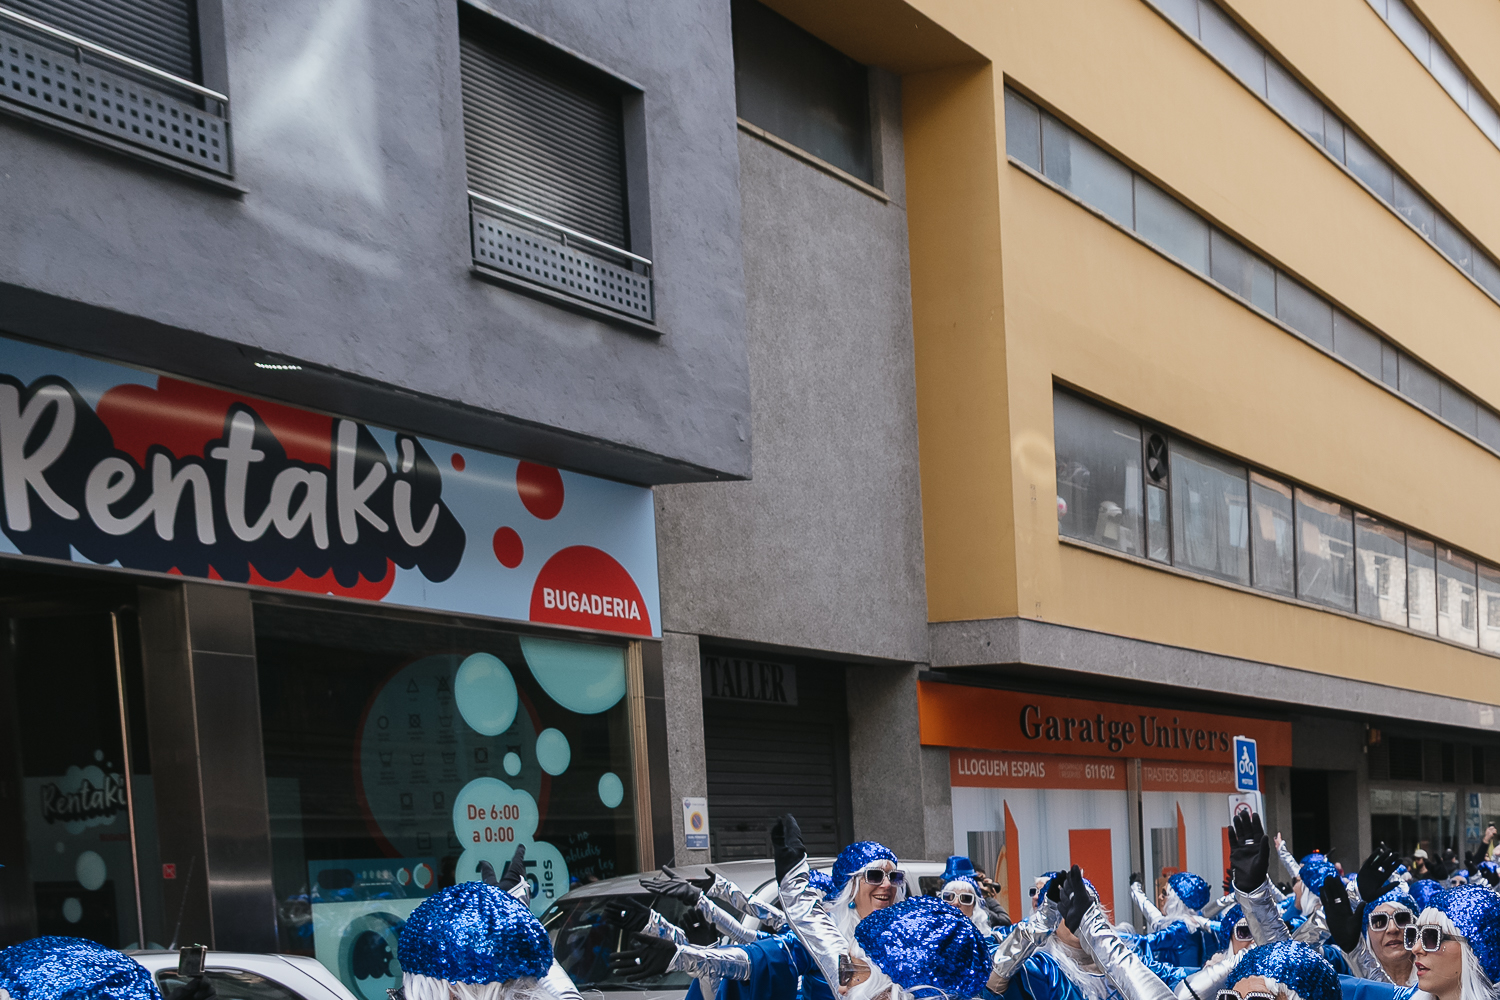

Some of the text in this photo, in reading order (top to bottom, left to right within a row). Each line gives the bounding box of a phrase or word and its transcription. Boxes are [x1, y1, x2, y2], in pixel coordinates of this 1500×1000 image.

[0, 383, 440, 549] Rentaki
[543, 587, 641, 621] BUGADERIA
[705, 657, 788, 703] TALLER
[1019, 704, 1230, 752] Garatge Univers
[958, 758, 1046, 778] LLOGUEM ESPAIS
[1085, 763, 1115, 780] 611 612
[1143, 767, 1179, 782] TRASTERS
[42, 774, 127, 815] Rentaki
[467, 804, 520, 820] De 6:00
[472, 826, 515, 843] a 0:00
[541, 859, 554, 900] dies
